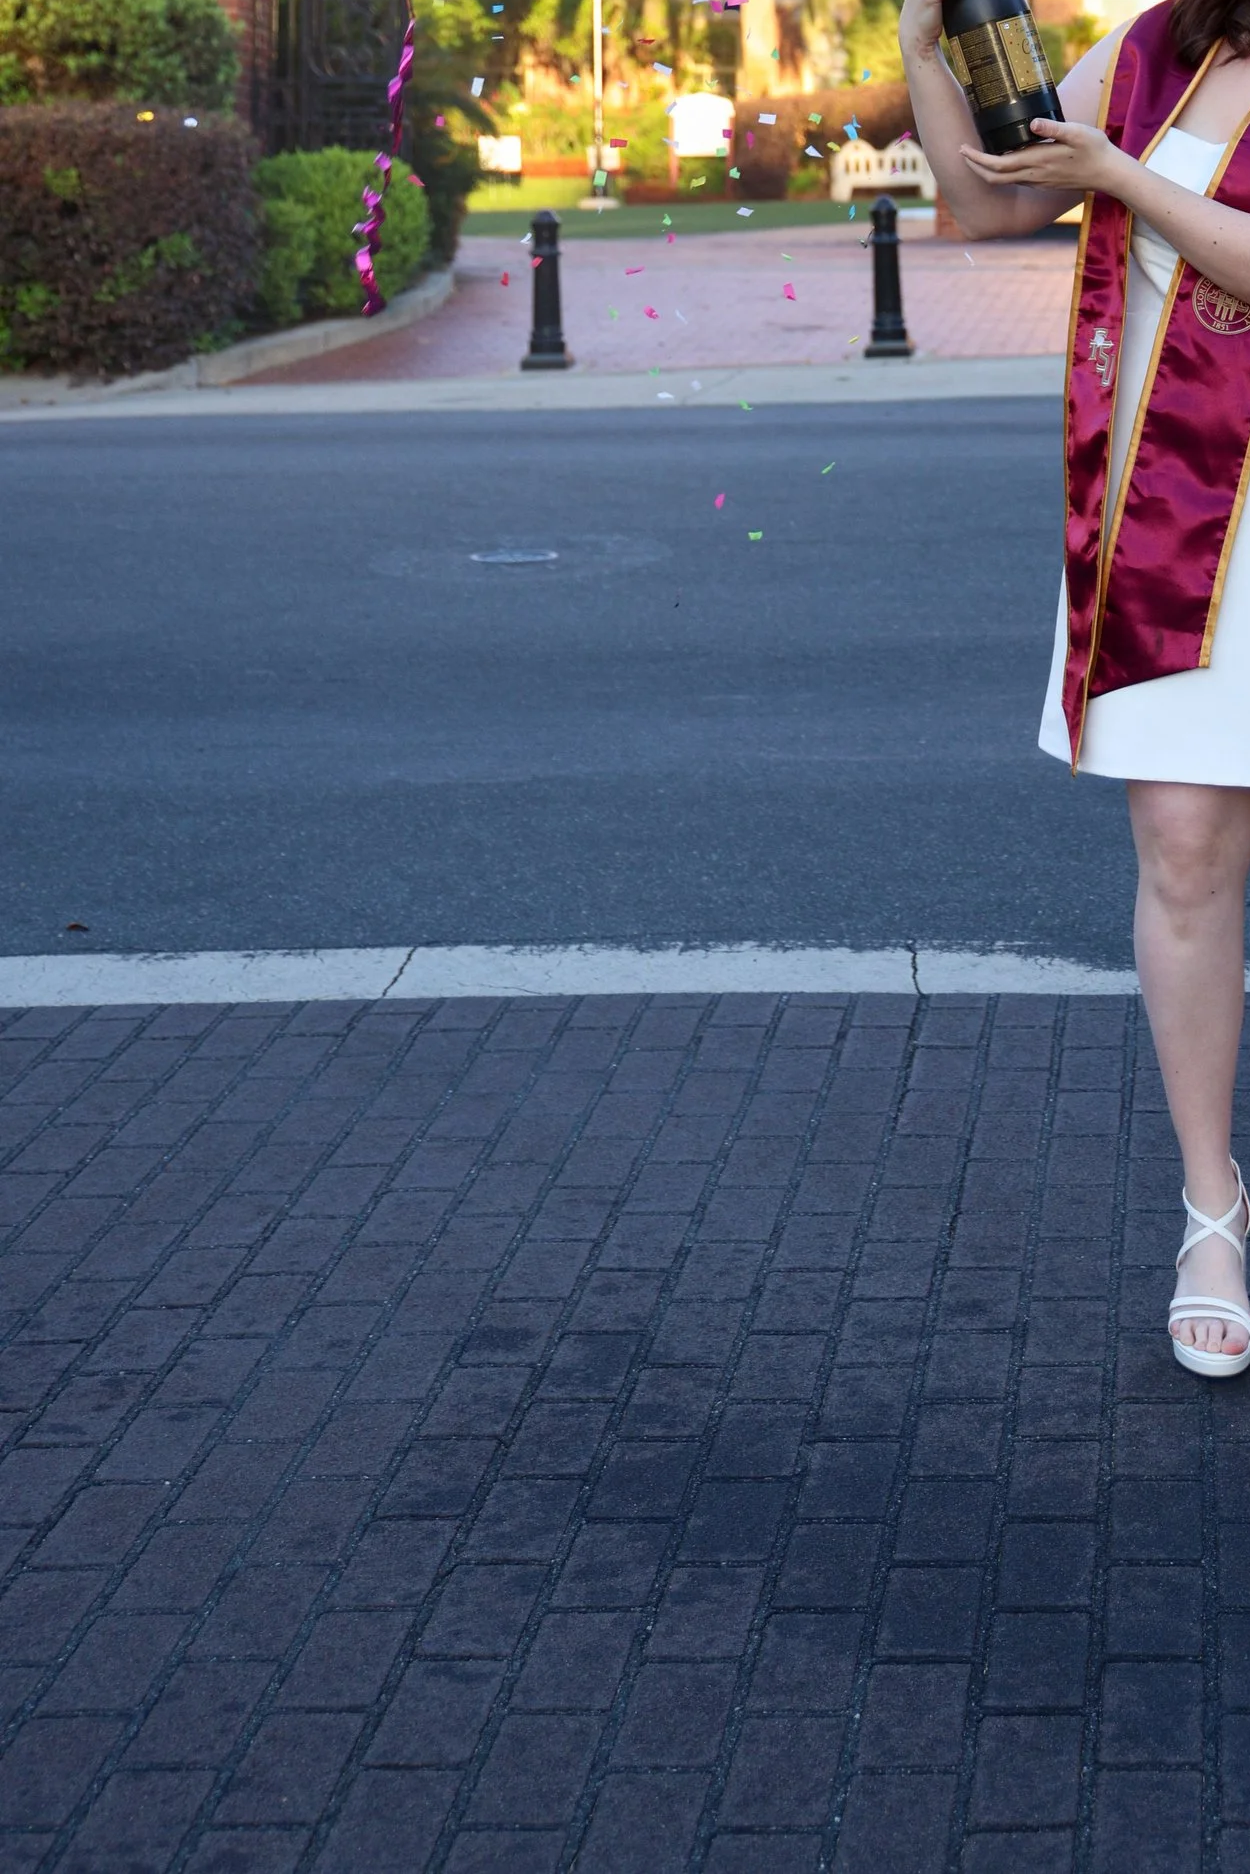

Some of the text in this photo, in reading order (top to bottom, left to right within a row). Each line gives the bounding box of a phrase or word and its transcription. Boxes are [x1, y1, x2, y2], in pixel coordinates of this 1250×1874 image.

[1196, 279, 1211, 311] FLORID
[1212, 321, 1229, 331] 1851
[1088, 327, 1115, 387] FSU
